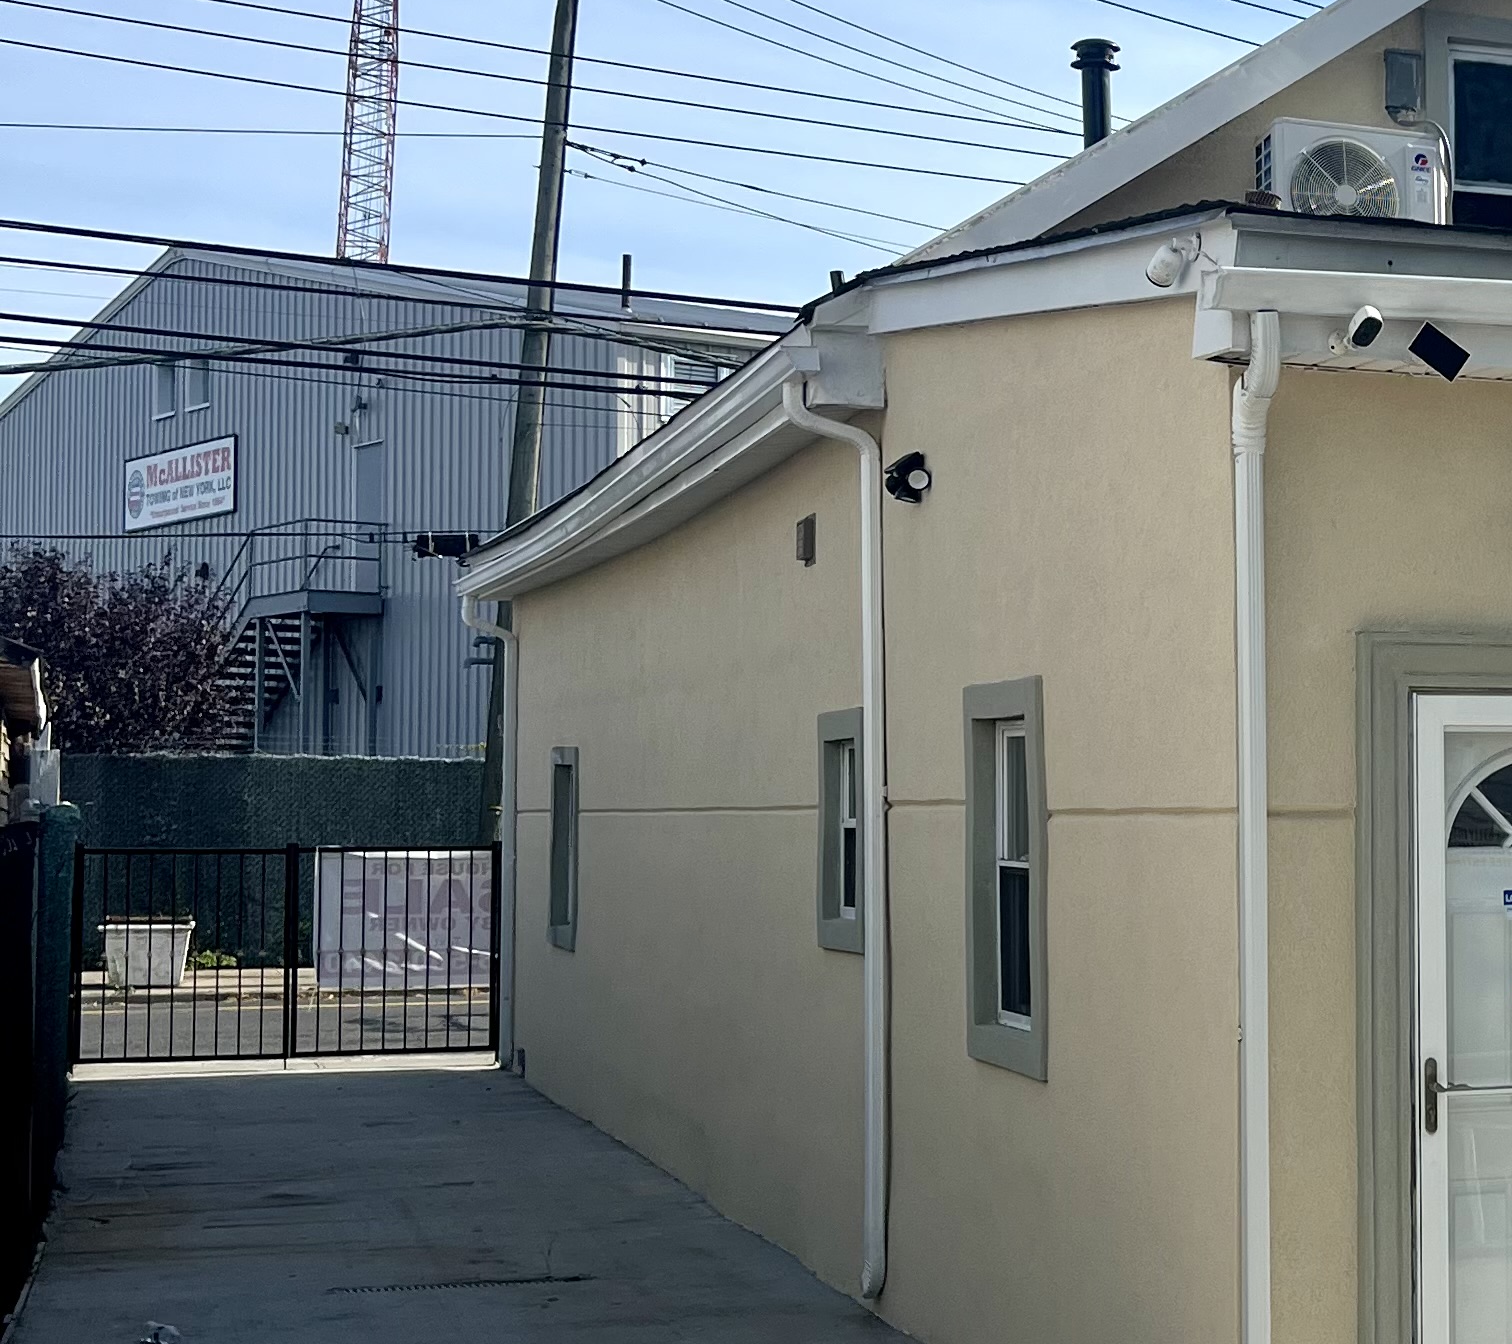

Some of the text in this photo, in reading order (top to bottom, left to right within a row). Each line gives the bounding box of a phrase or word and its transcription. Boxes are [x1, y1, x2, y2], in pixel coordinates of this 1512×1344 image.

[146, 447, 231, 488] McALLISTER
[180, 485, 194, 499] NEW
[217, 476, 231, 491] LLC
